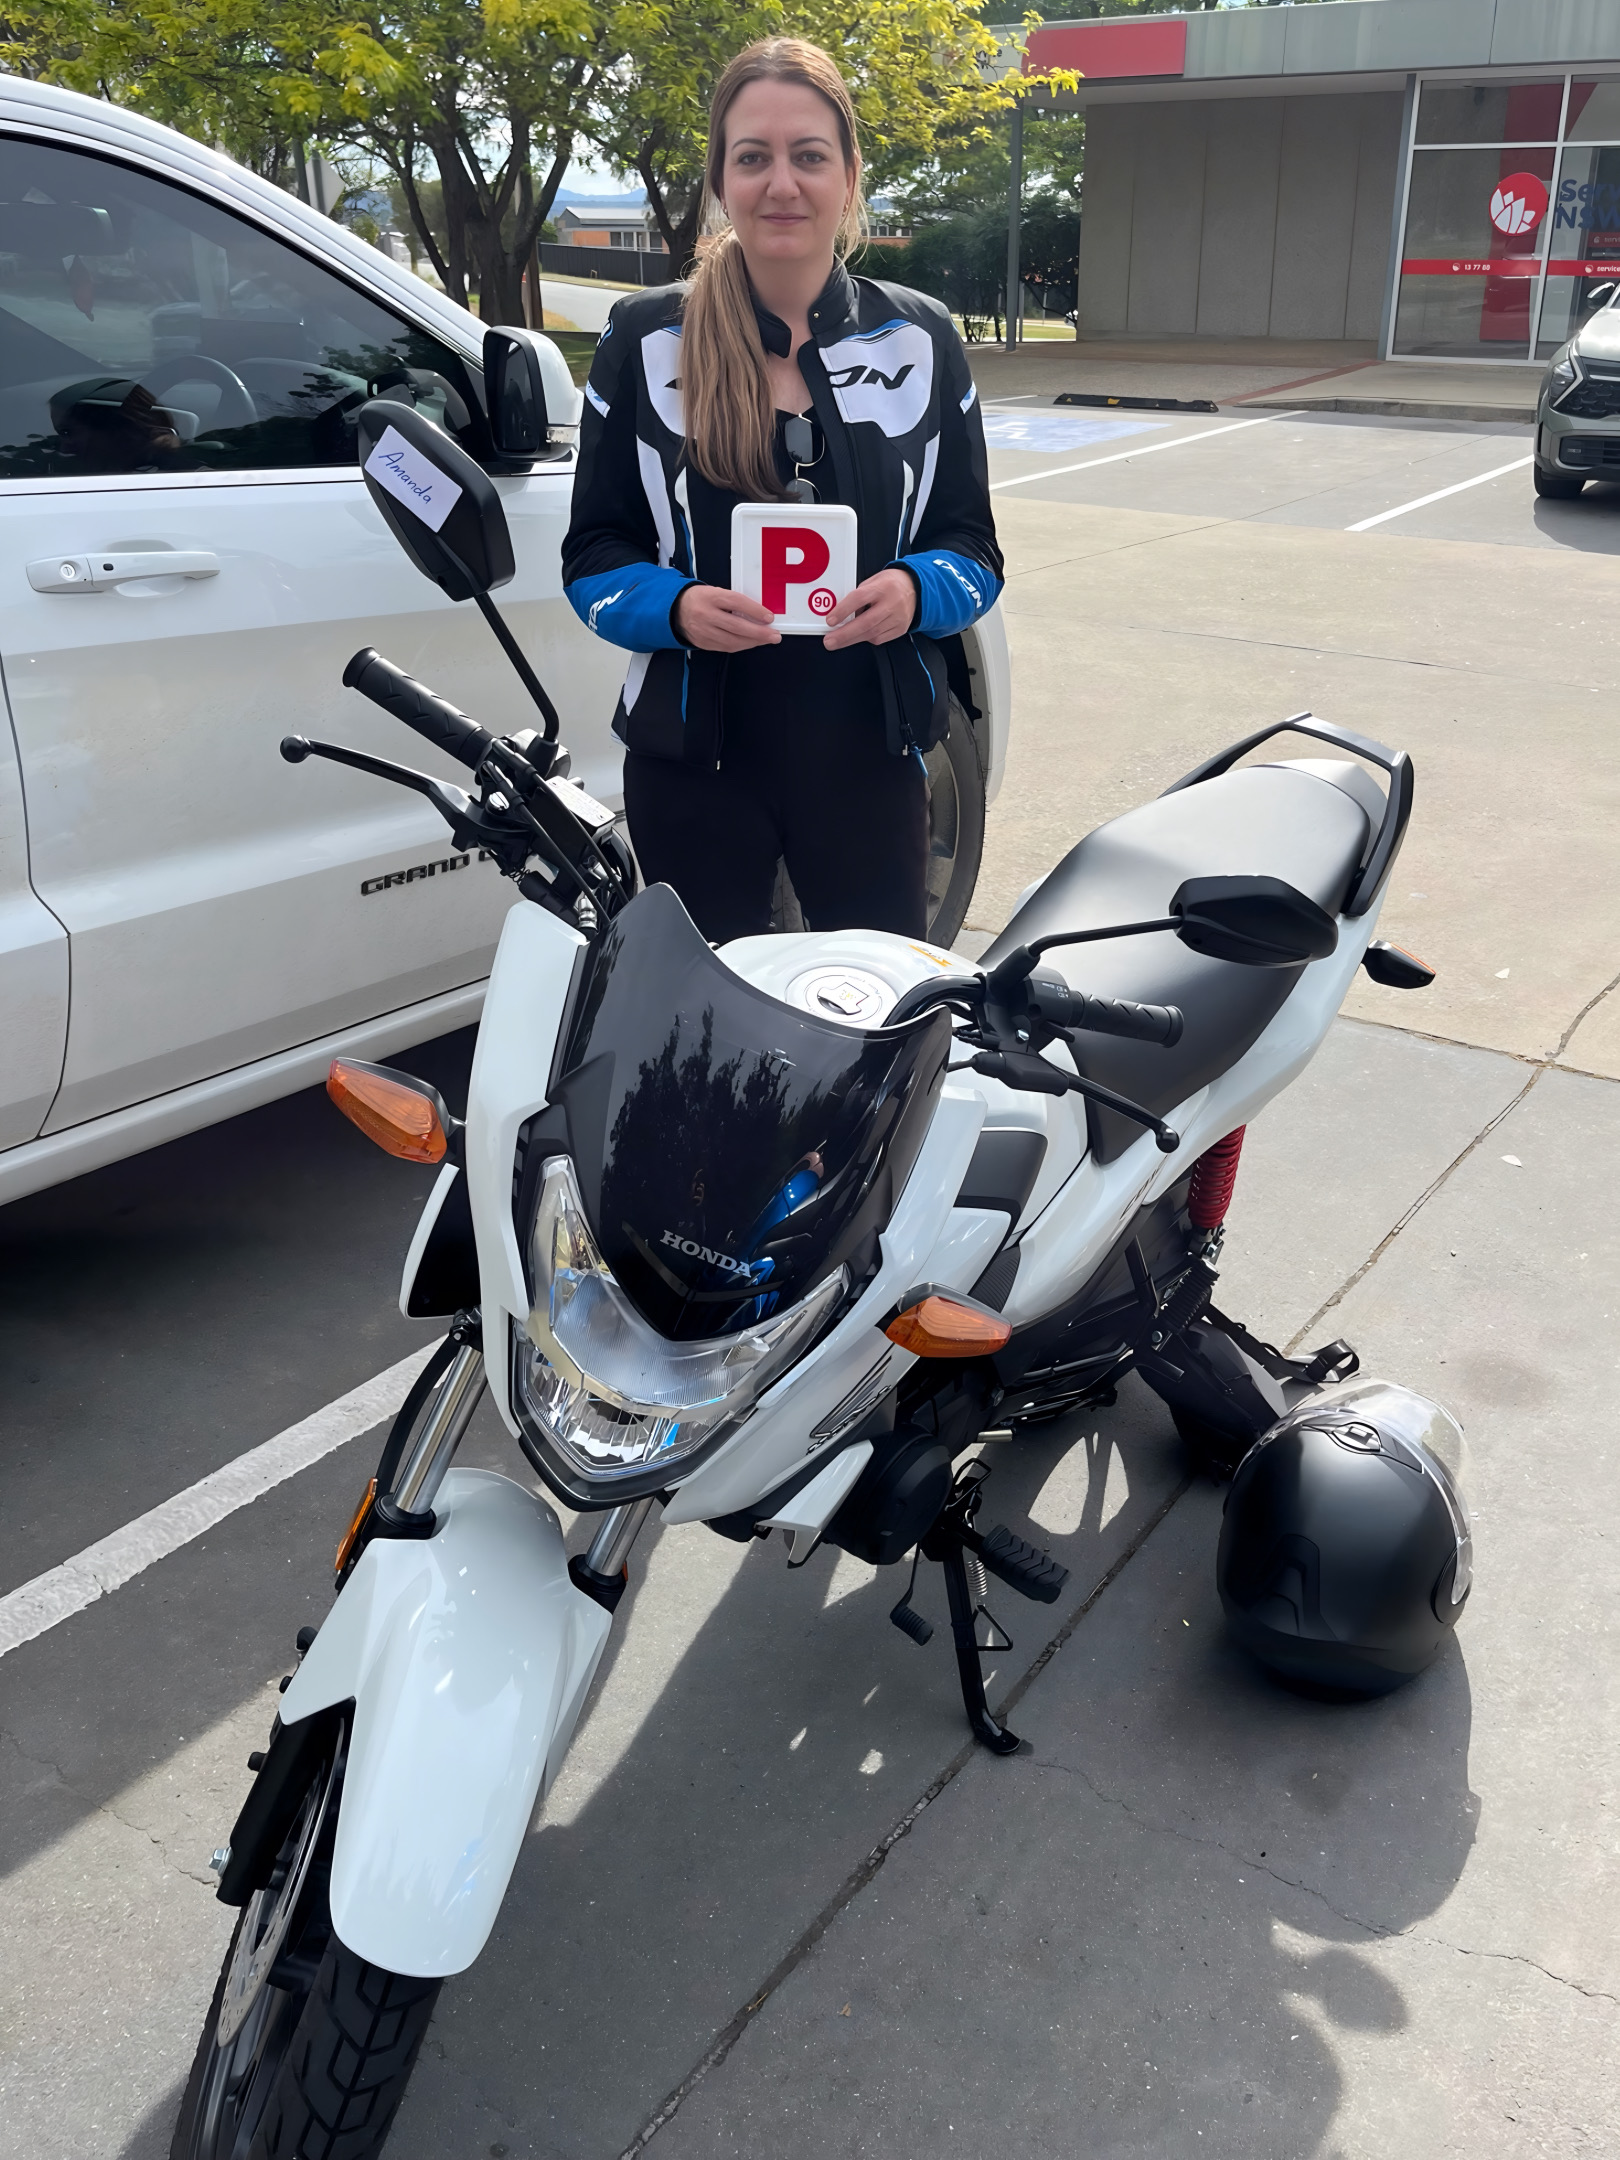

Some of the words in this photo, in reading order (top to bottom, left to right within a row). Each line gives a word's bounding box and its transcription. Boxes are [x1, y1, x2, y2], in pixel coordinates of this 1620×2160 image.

[378, 452, 432, 504] Amanda
[762, 527, 830, 614] P
[814, 596, 830, 608] 90
[361, 853, 470, 896] GRAND
[660, 1230, 752, 1278] HONDA
